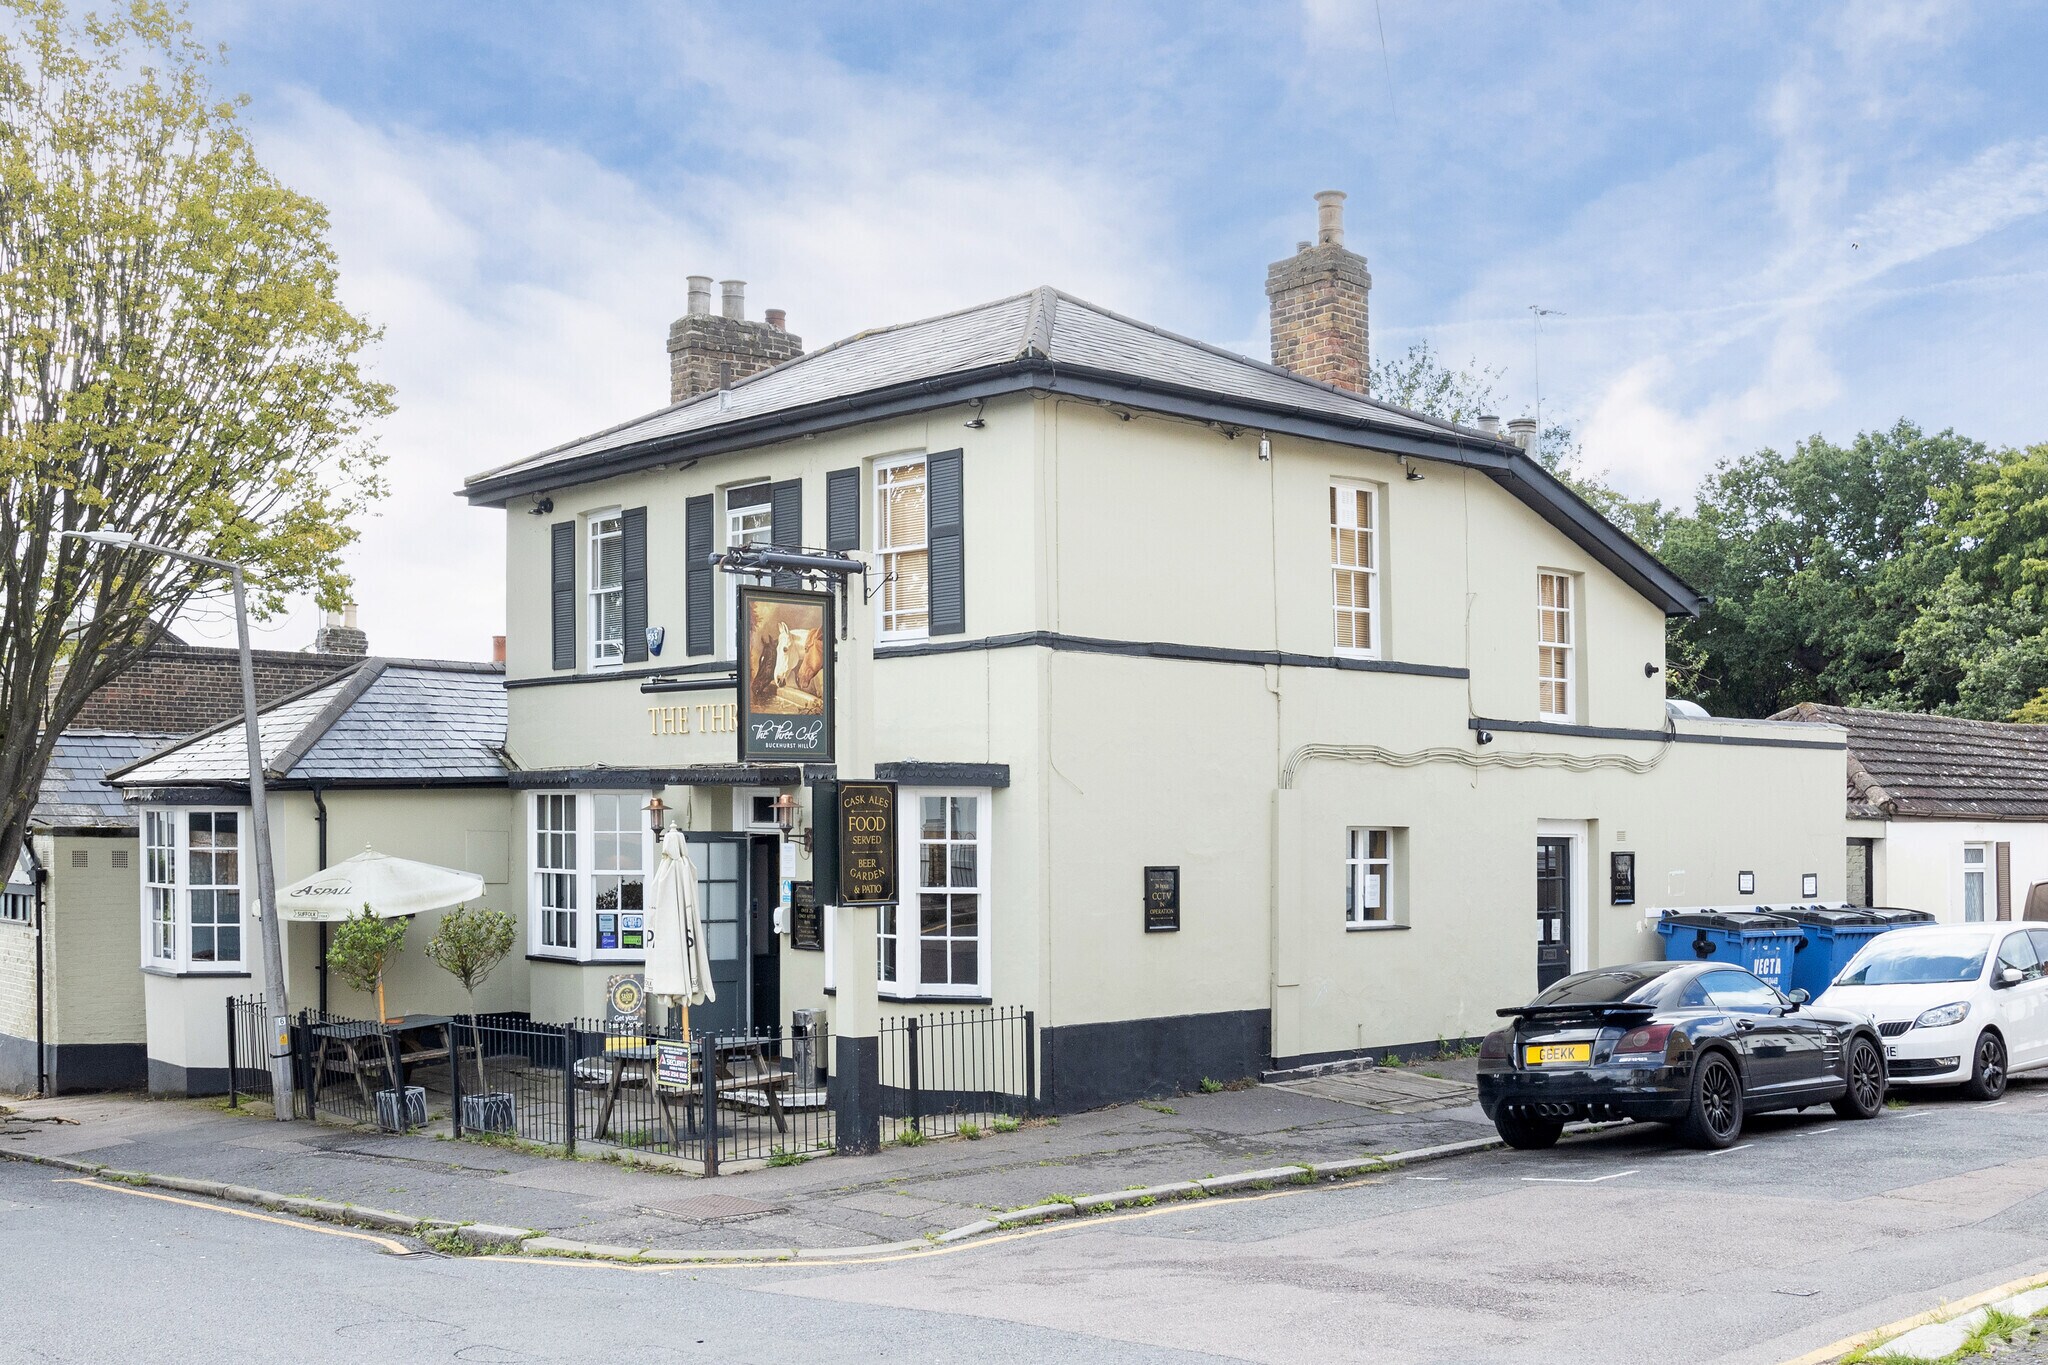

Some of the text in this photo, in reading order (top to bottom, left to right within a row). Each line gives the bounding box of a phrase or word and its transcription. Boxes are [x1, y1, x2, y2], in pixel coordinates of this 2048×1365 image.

[648, 707, 690, 736] THE
[752, 720, 774, 741] The
[771, 720, 793, 741] Three
[844, 795, 890, 808] CASK ALES
[848, 816, 886, 832] FOOD
[852, 835, 882, 845] SERVED
[858, 858, 877, 868] BEER
[849, 867, 886, 881] GARDEN
[290, 885, 352, 897] ASPALL
[853, 884, 882, 894] & PATIO
[1152, 892, 1171, 900] CCTV
[1753, 958, 1781, 975] VECTA
[614, 1014, 639, 1023] Get your
[666, 1058, 687, 1068] SECURITY
